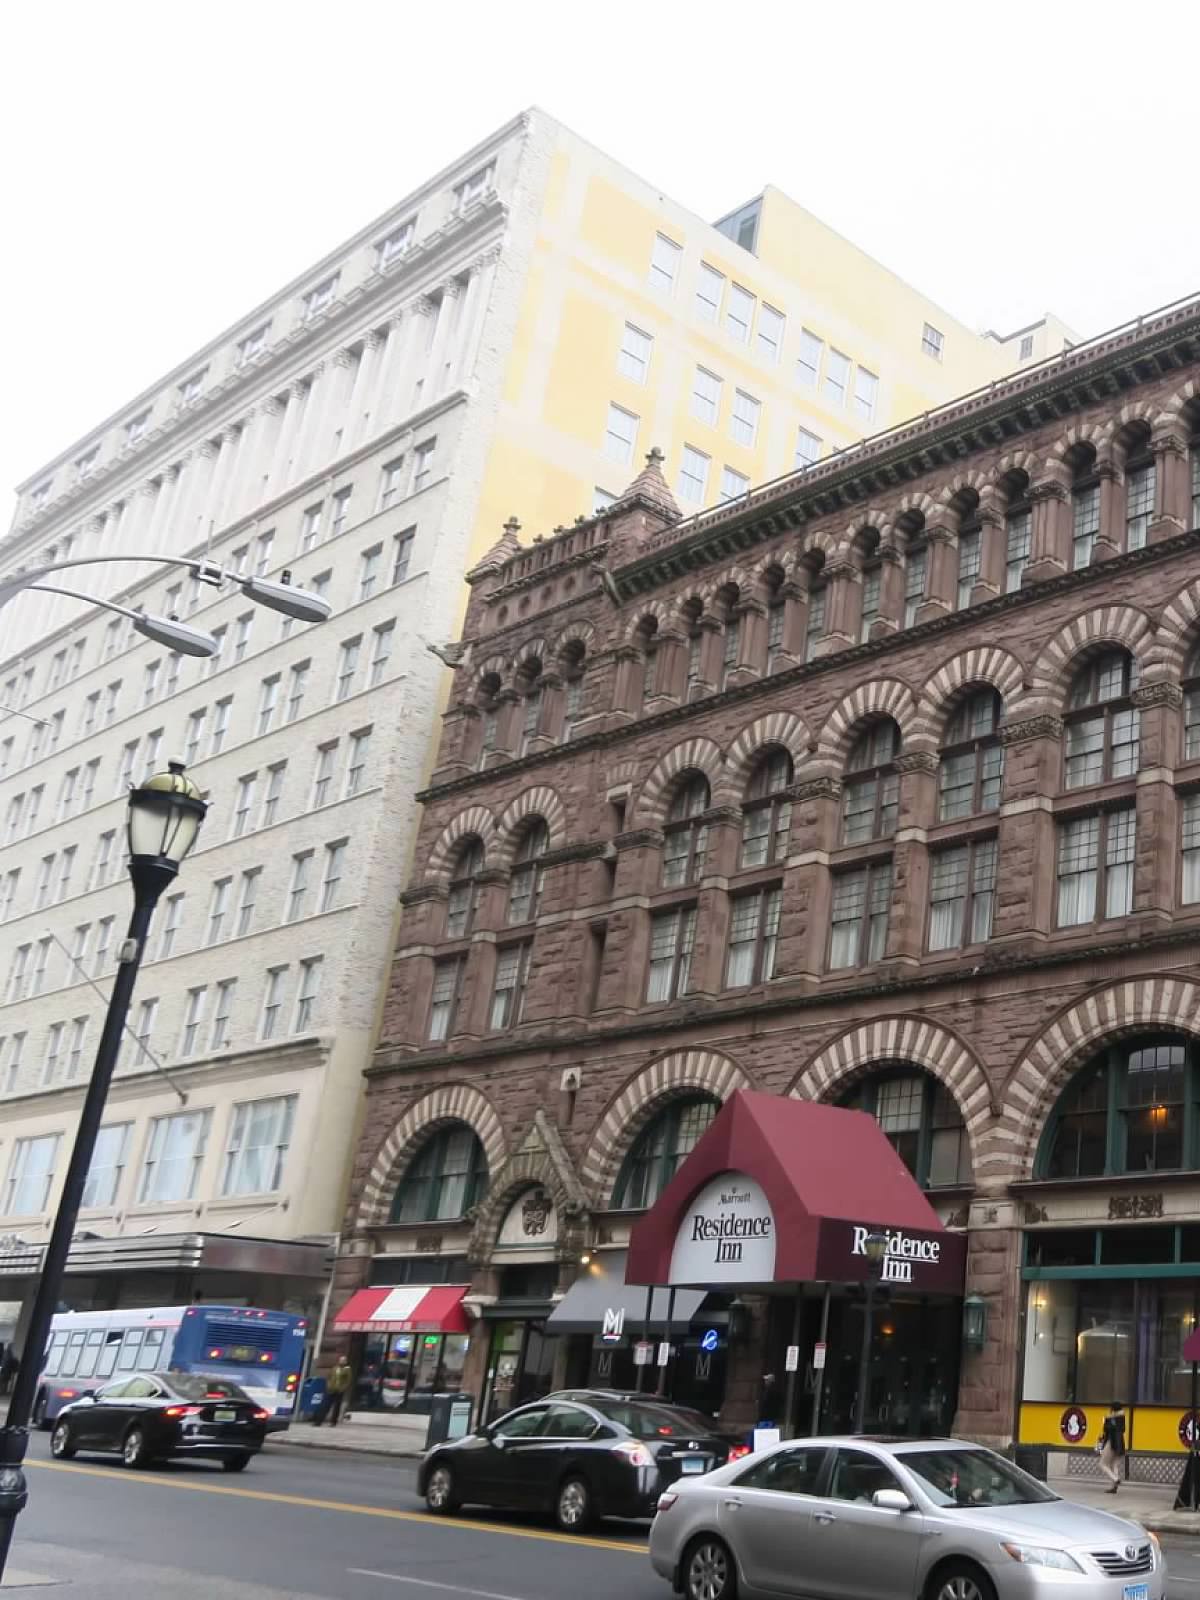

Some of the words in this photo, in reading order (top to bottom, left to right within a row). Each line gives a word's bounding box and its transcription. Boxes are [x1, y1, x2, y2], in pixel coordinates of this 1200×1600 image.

[691, 1213, 771, 1241] Residence
[714, 1239, 742, 1263] Inn
[851, 1226, 940, 1260] Ridence
[880, 1254, 912, 1281] Inn
